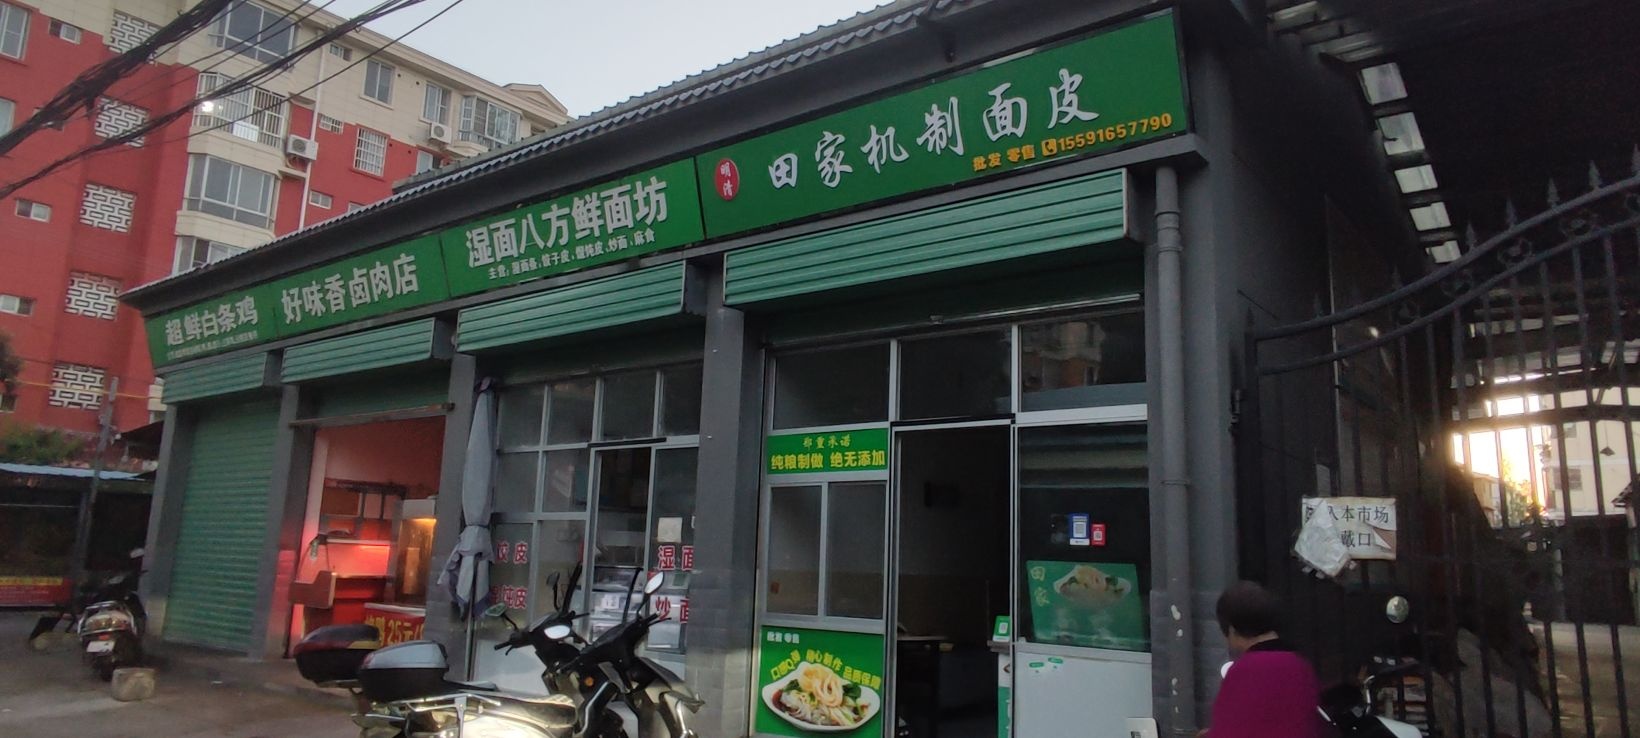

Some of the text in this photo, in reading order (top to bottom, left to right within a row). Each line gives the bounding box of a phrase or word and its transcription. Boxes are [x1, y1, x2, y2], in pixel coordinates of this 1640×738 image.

[768, 67, 1099, 189] 田家机制面皮
[972, 112, 1173, 172] 批发 零售 15591657790
[465, 176, 668, 268] 湿面八方鲜面坊
[165, 296, 258, 346] 超鲜白条鸡
[281, 252, 420, 325] 好味香卤肉店
[829, 449, 886, 468] 绝无添加
